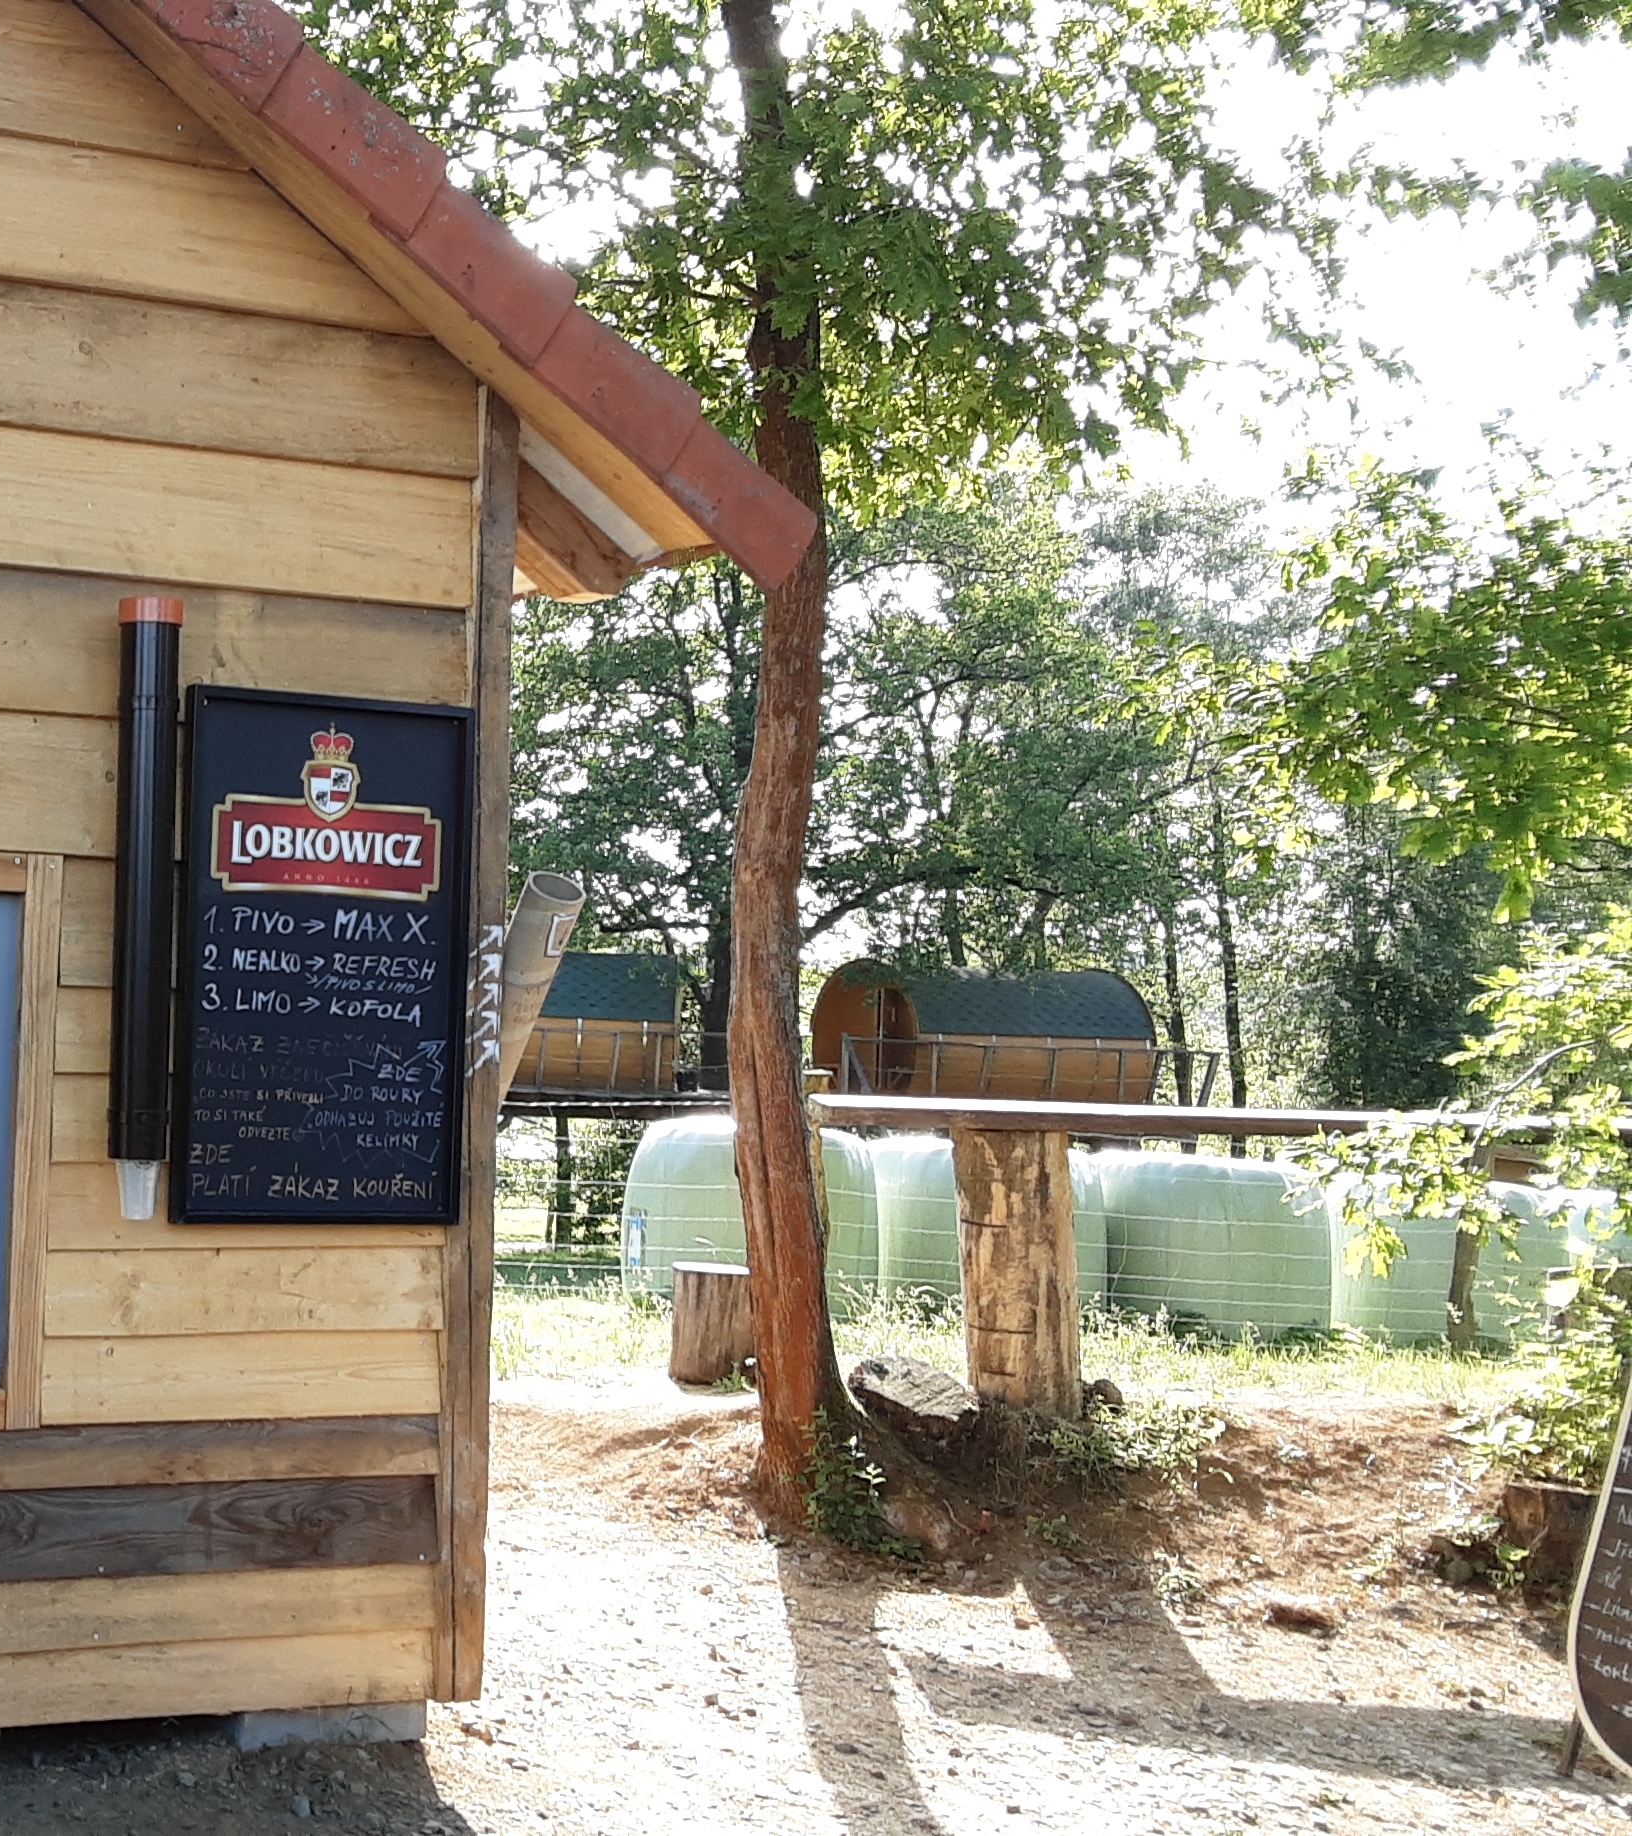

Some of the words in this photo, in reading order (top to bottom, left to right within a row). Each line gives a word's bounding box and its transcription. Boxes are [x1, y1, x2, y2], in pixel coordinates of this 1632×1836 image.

[230, 819, 423, 868] LOBKOWICZ
[282, 872, 326, 883] ANNO
[231, 906, 295, 935] PIVO
[232, 947, 301, 974] NEALKO
[332, 953, 437, 981] REFRESH
[236, 989, 292, 1014] LIMO
[329, 996, 421, 1028] KOFOLA
[377, 1063, 423, 1083] ZDE
[340, 1084, 364, 1102] DO
[371, 1085, 424, 1106] ROURY
[195, 1109, 210, 1122] TO
[190, 1143, 233, 1164] ZDE
[268, 1162, 339, 1200] ZÁKAZ
